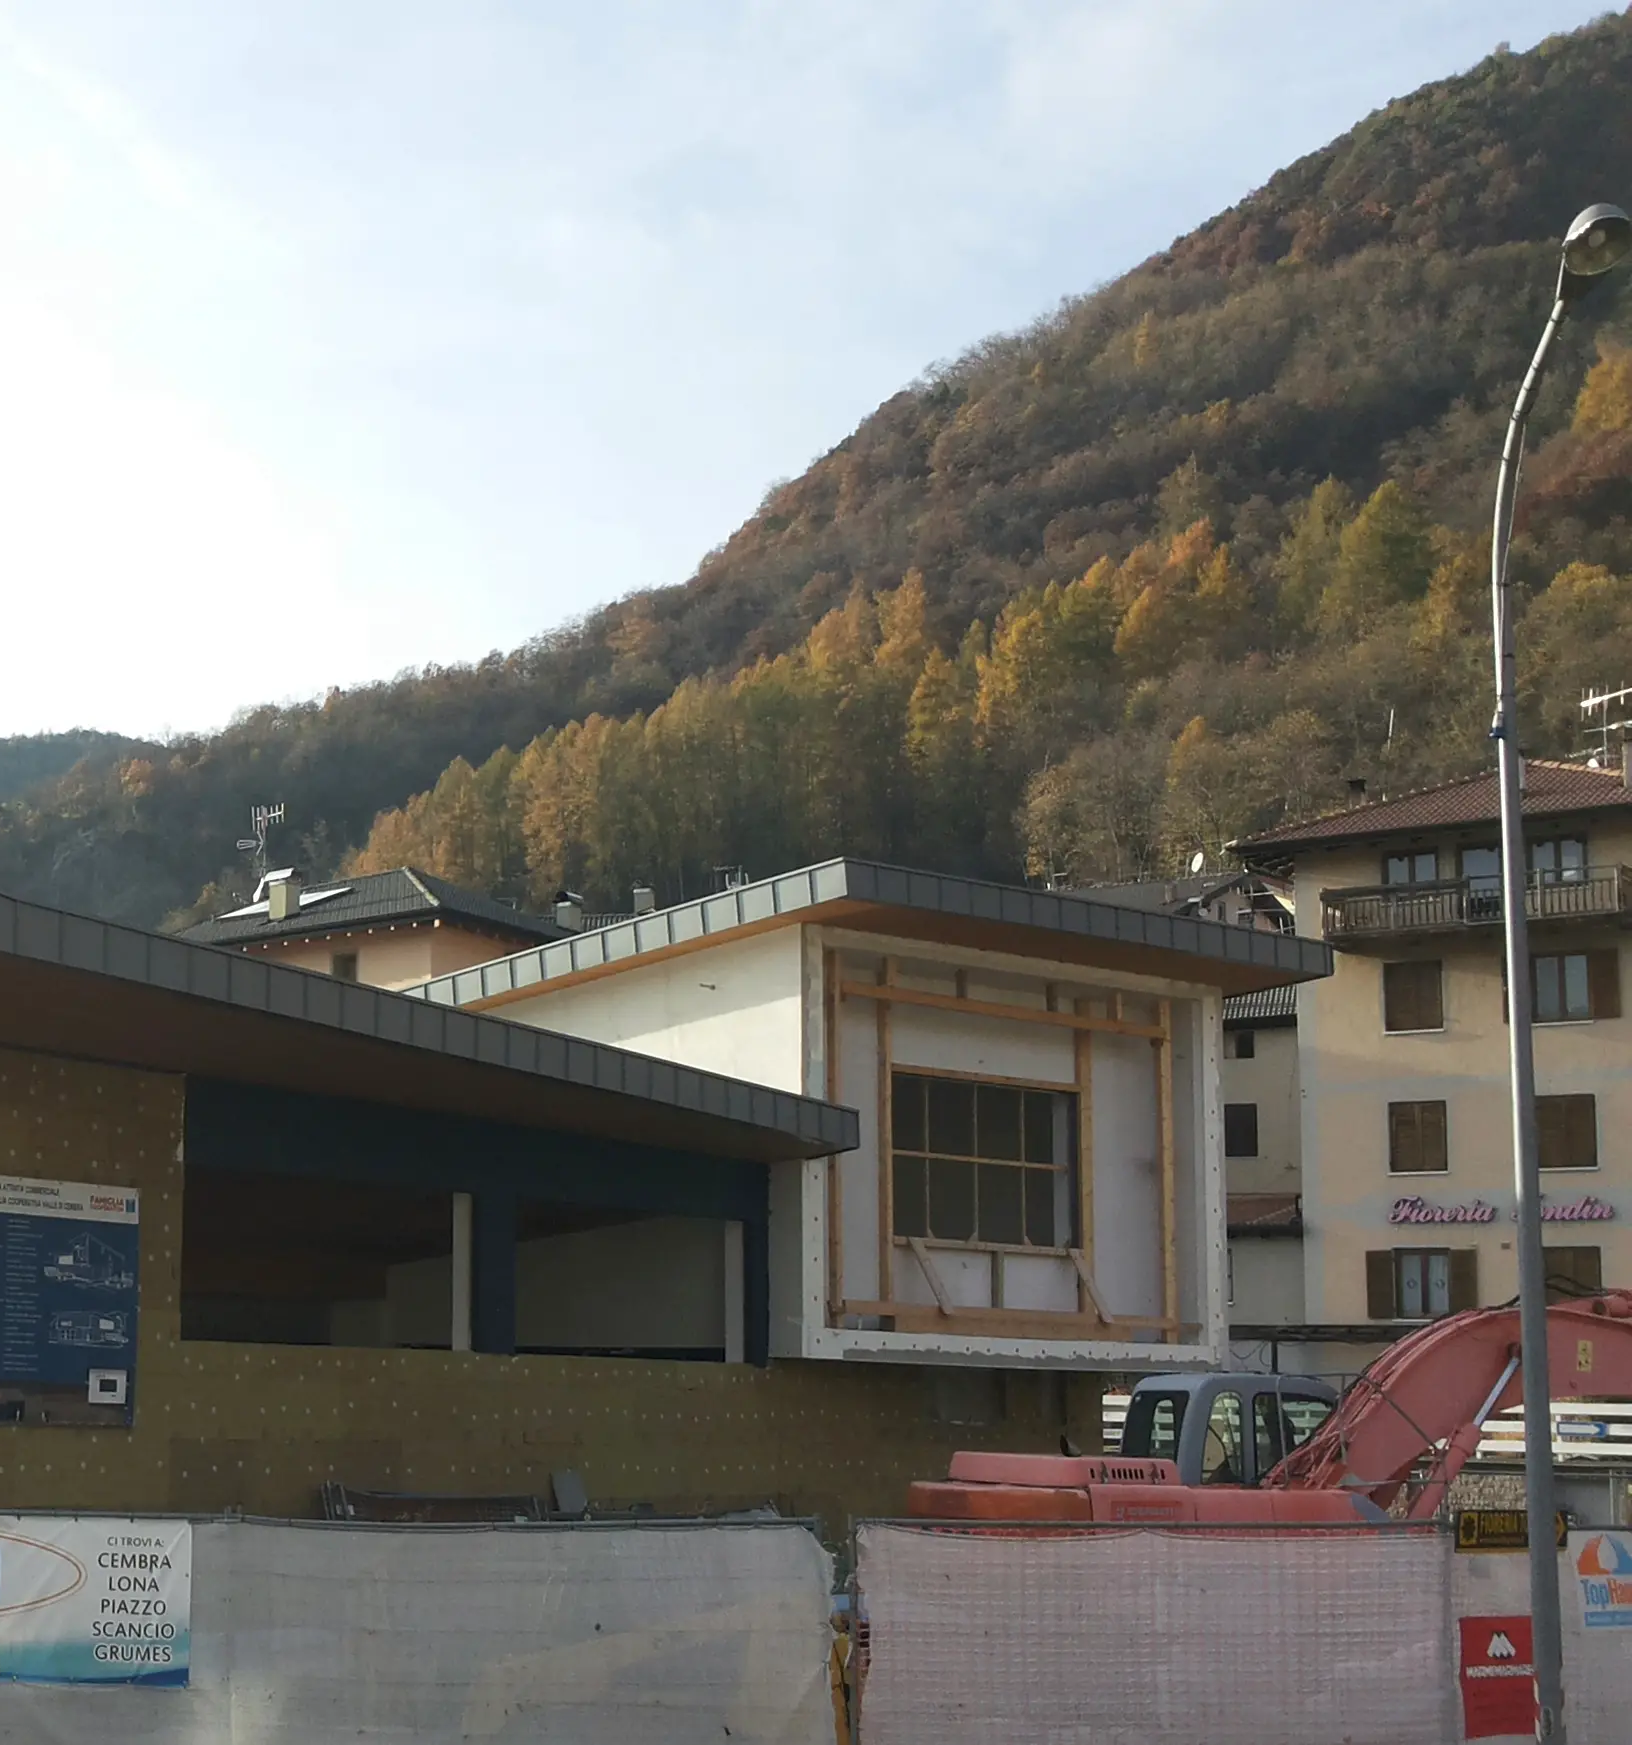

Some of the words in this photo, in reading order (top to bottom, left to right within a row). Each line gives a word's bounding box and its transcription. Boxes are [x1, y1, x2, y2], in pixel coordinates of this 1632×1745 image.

[1389, 1196, 1495, 1224] Fioreria
[107, 1537, 118, 1547] CI
[121, 1537, 152, 1547] TROVI
[97, 1552, 172, 1569] CEMBRA
[108, 1576, 160, 1592] LONA
[100, 1599, 167, 1616] PIAZZO
[92, 1621, 175, 1639] SCANCIO
[94, 1644, 172, 1662] GRUMES
